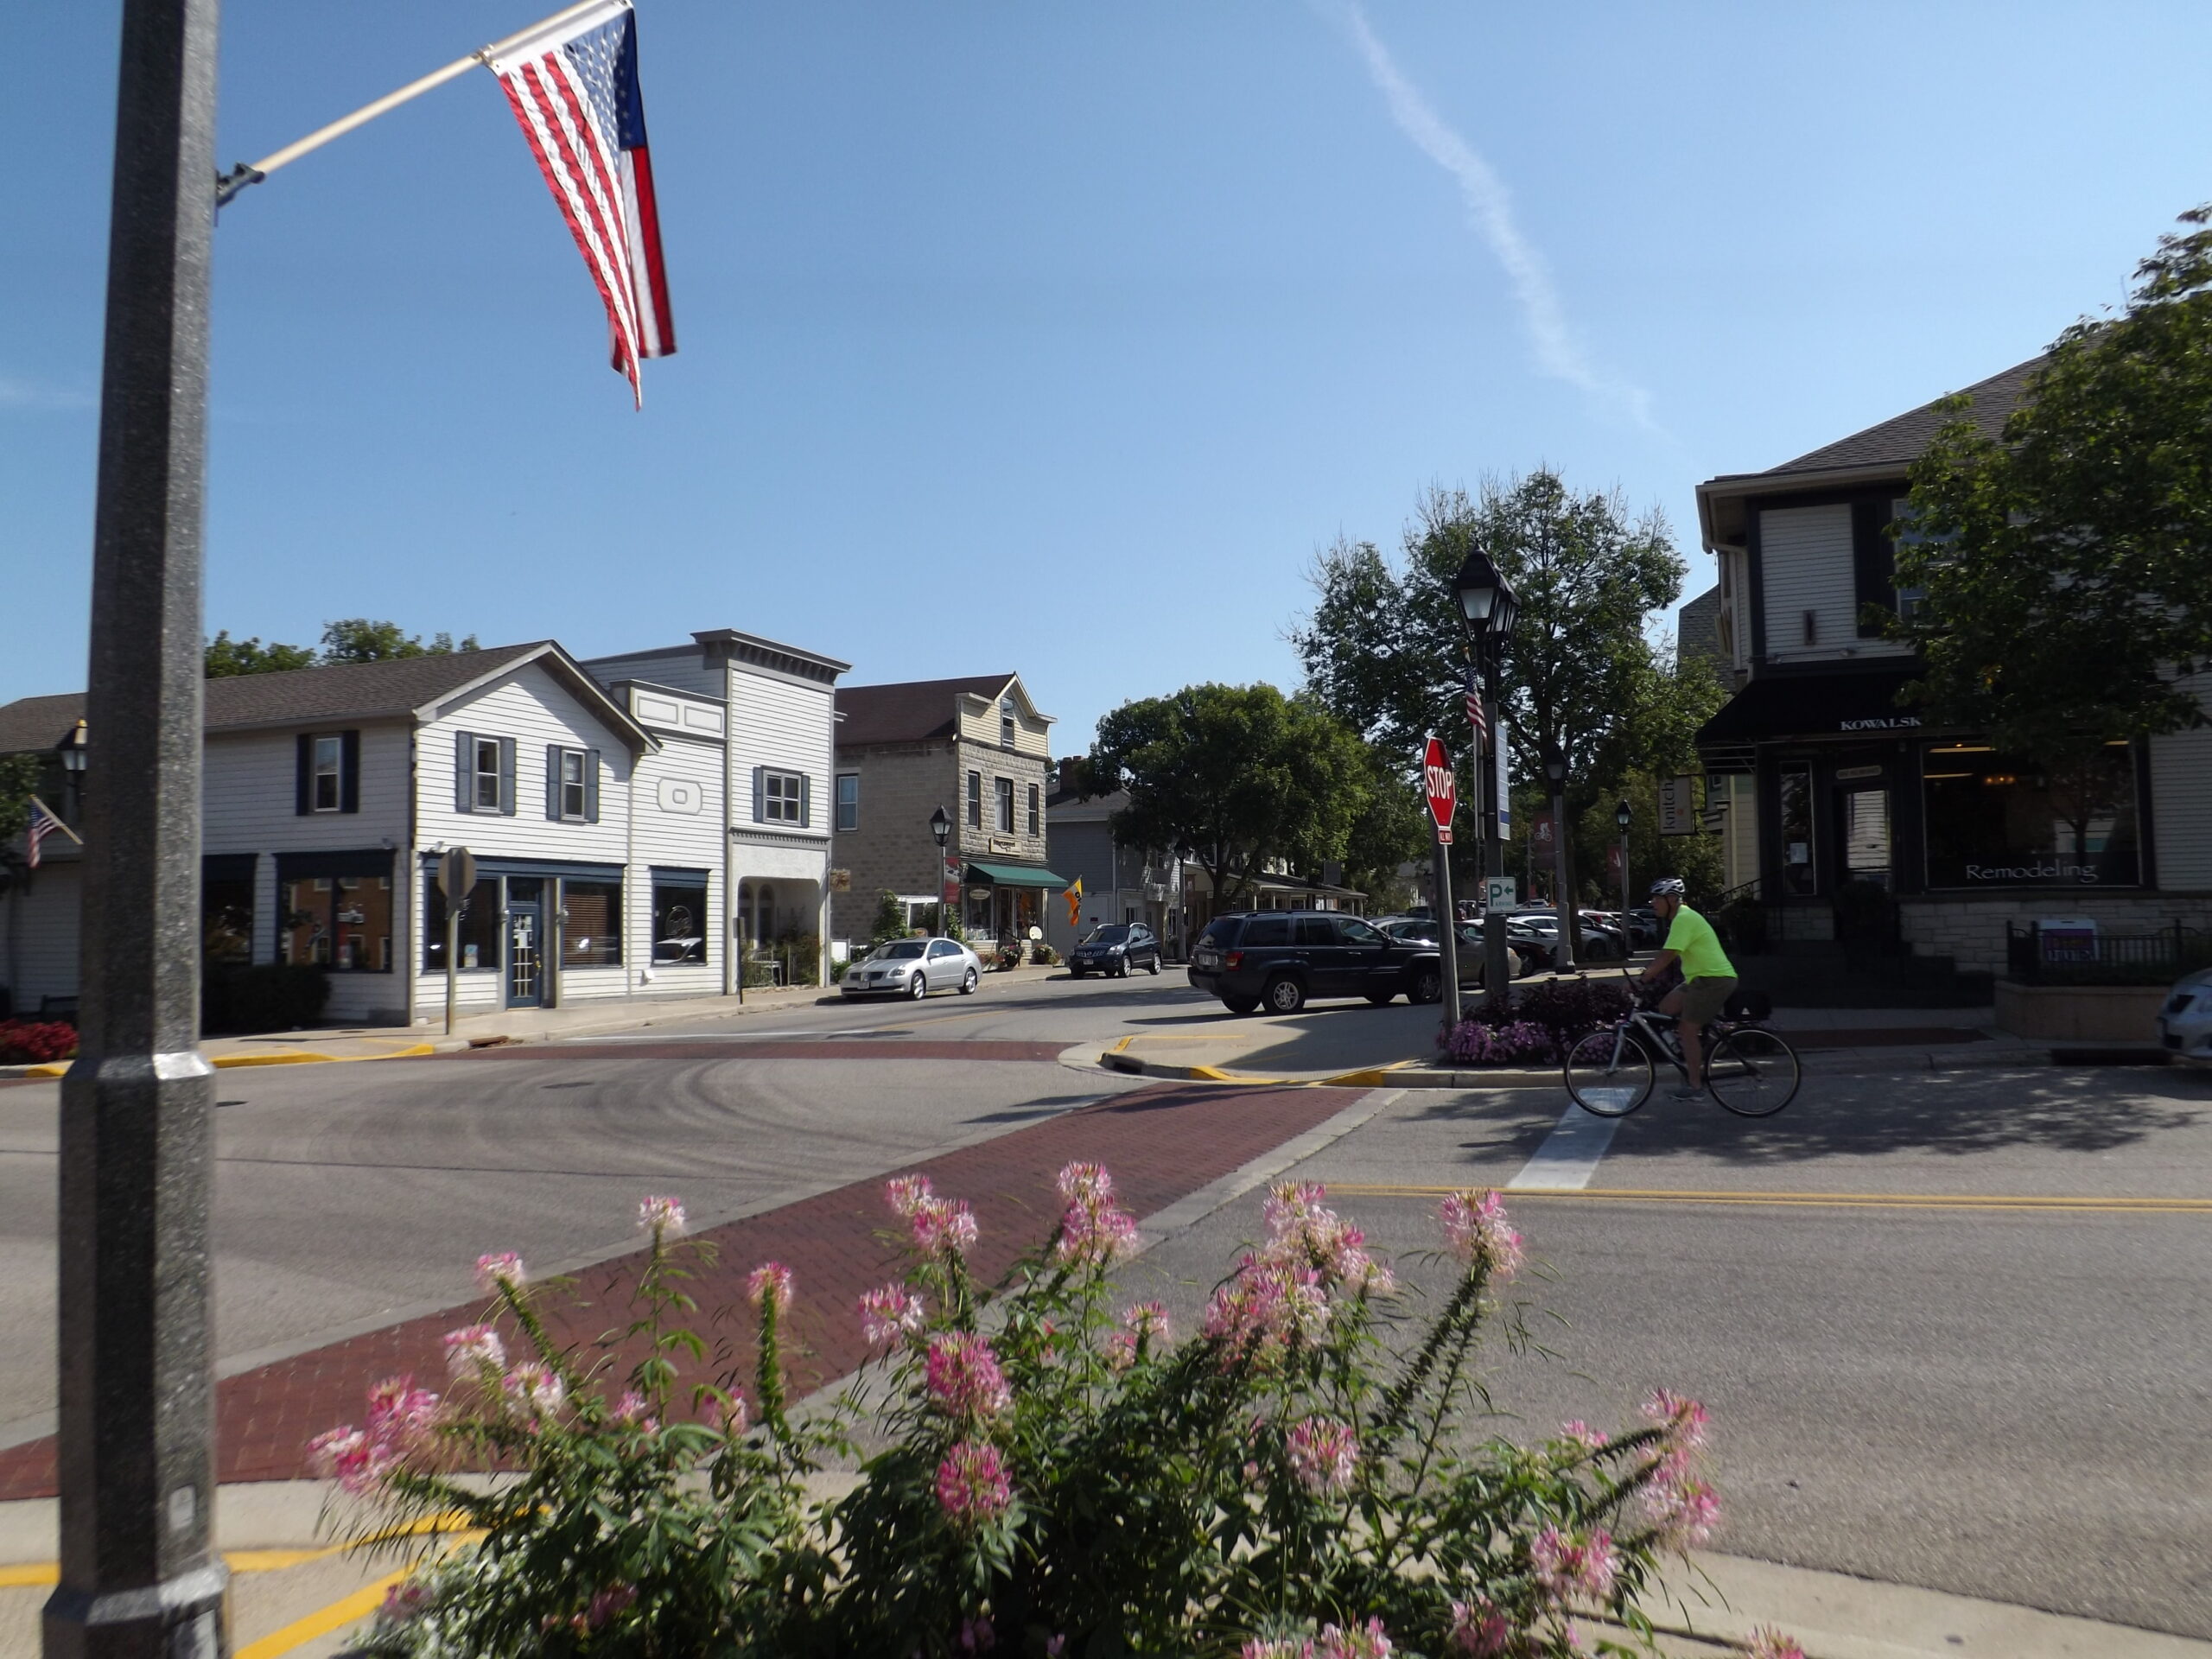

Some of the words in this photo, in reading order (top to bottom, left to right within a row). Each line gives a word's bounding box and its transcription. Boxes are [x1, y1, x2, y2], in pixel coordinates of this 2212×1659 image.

[1840, 716, 1923, 731] KOWALSK
[1427, 765, 1452, 800] STOP
[1662, 781, 1675, 830] knitch
[1965, 858, 2100, 884] Remodeling
